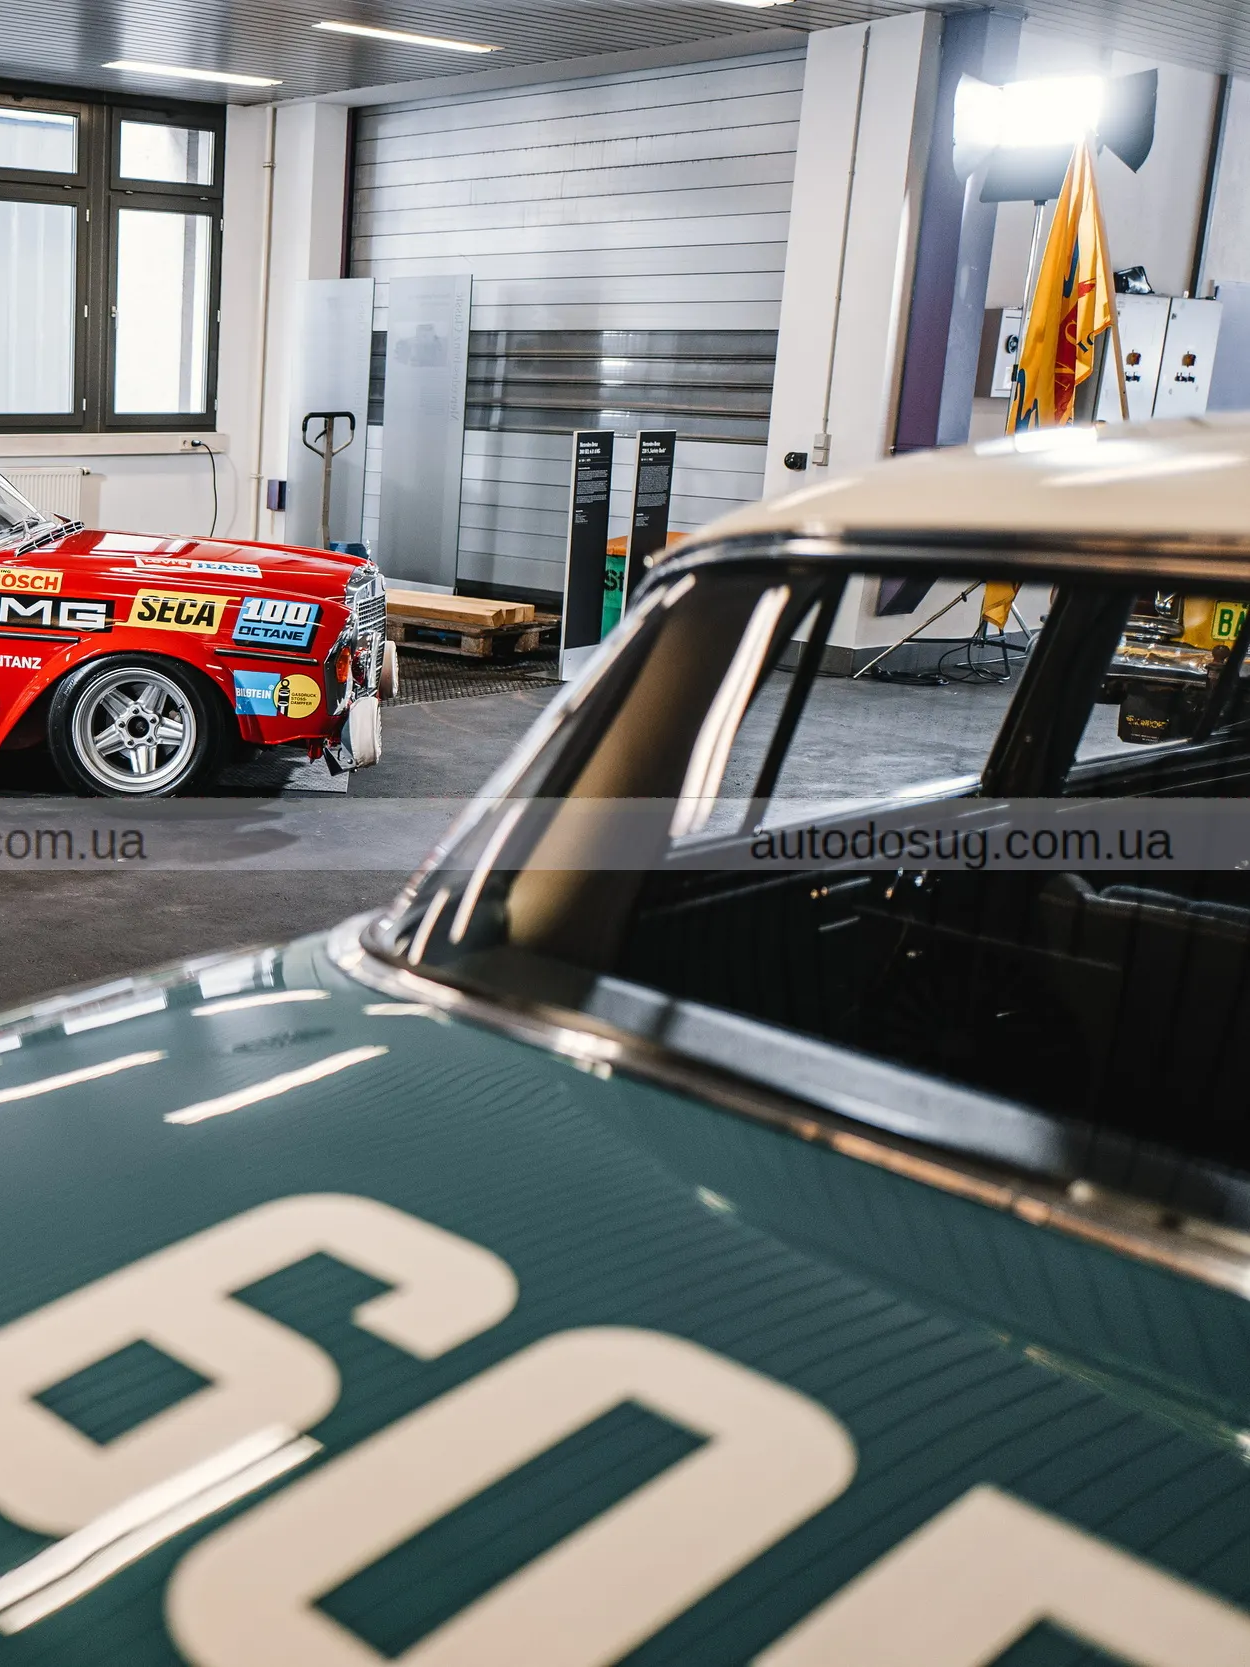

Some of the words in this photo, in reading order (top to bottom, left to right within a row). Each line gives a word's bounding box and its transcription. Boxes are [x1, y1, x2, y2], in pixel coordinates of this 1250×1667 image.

[137, 595, 216, 627] SECA
[241, 598, 312, 626] 100
[238, 625, 305, 641] OCTANE
[235, 687, 272, 700] BILSTEIN
